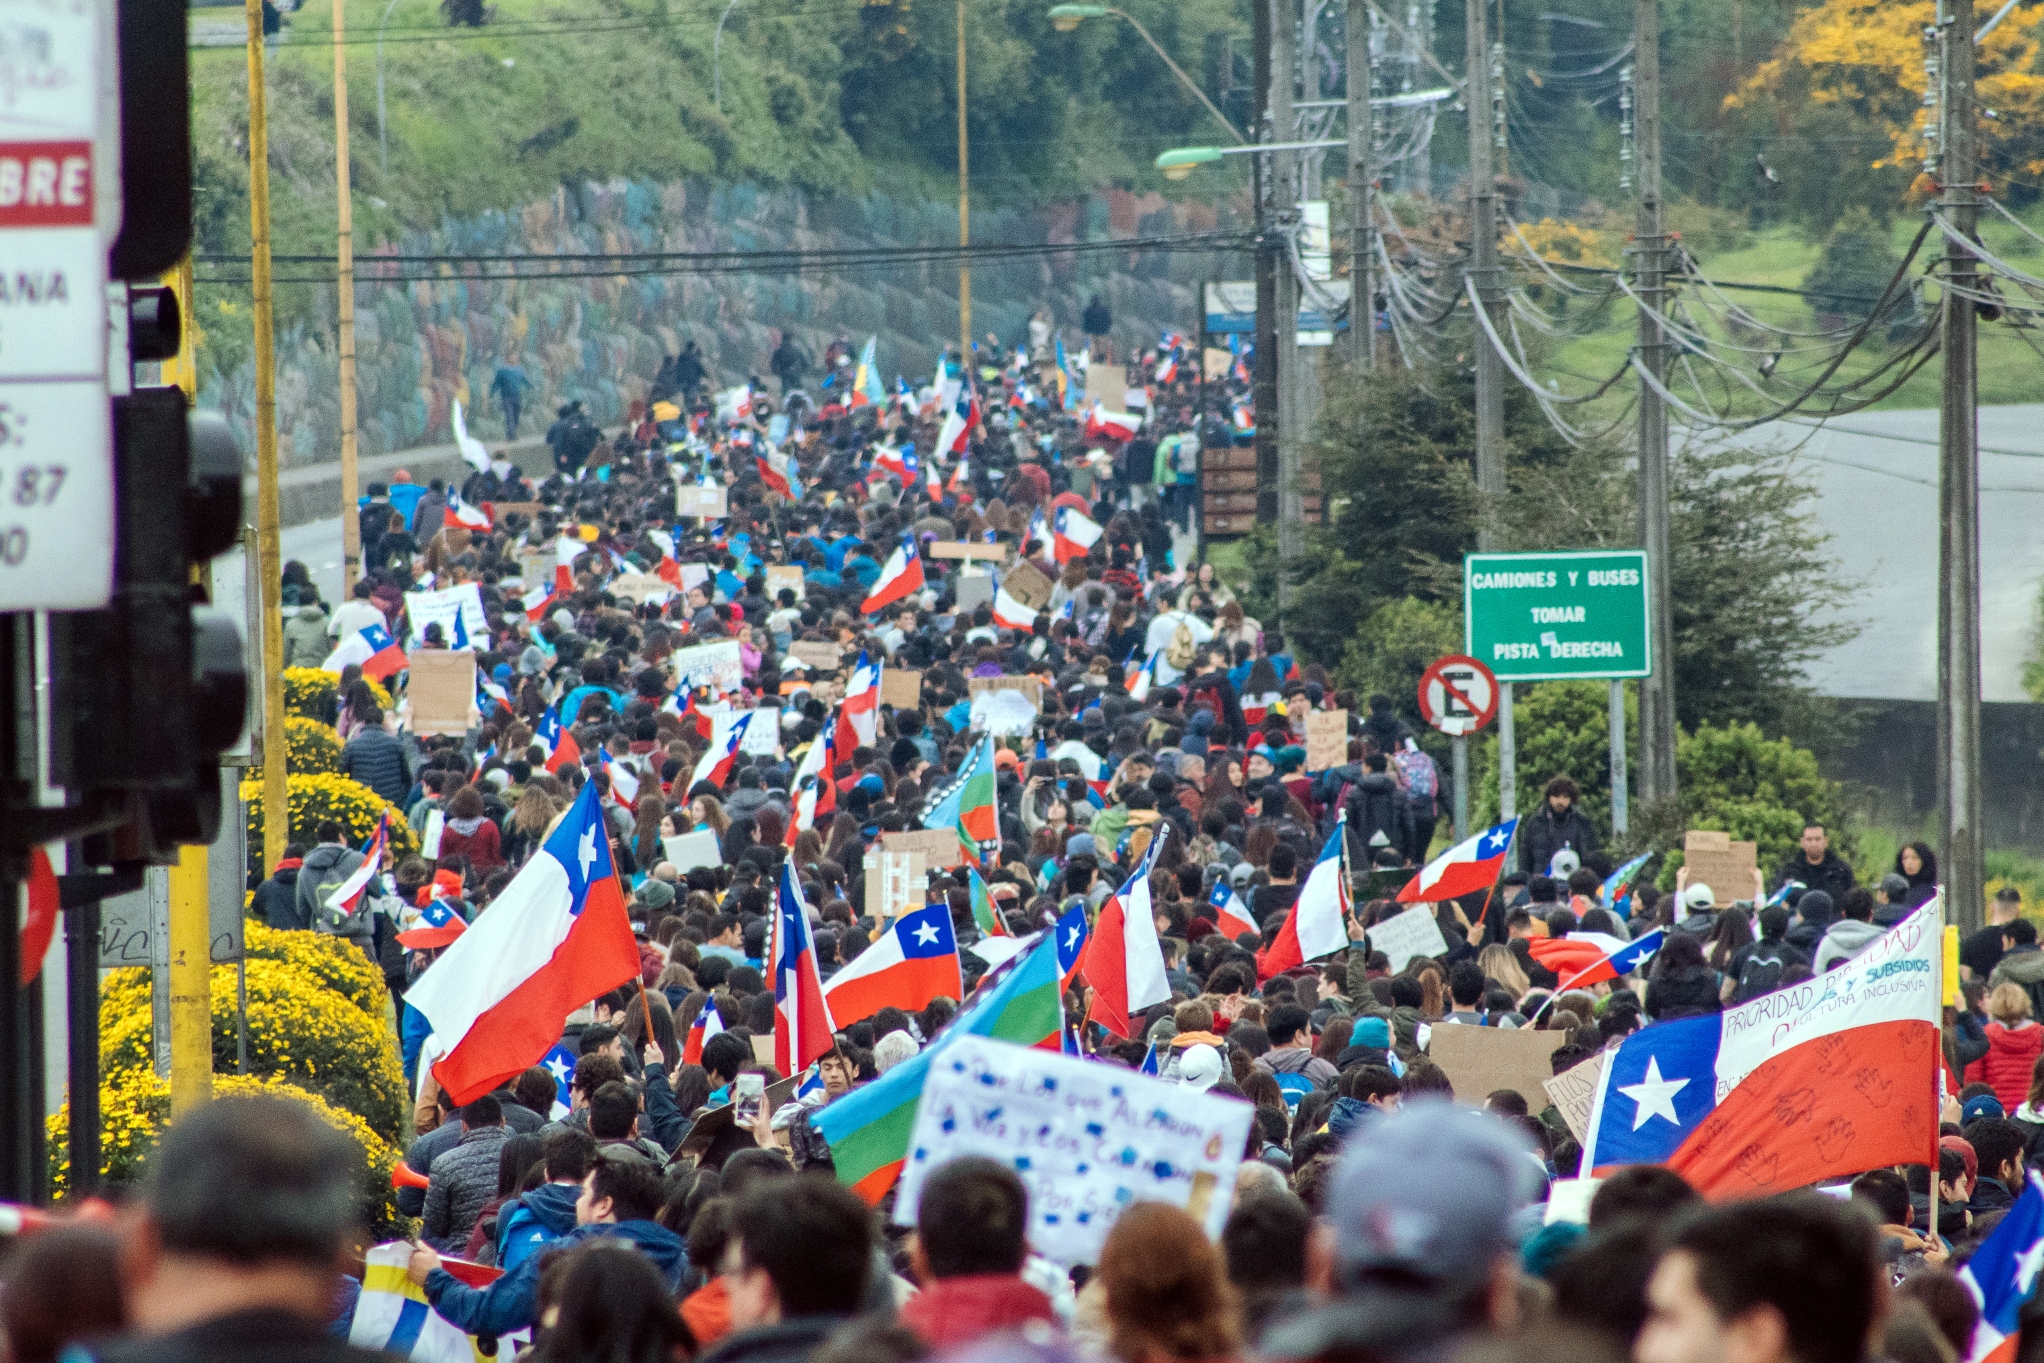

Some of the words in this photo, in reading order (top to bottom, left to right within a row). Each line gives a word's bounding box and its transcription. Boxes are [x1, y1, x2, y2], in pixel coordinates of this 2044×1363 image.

[1472, 571, 1557, 589] CAMIONES
[1568, 571, 1579, 587] Y
[1588, 569, 1640, 586] BUSES
[1530, 606, 1586, 623] TOMAR
[1493, 643, 1540, 660] PISTA
[1550, 641, 1623, 658] DERECHA
[1866, 959, 1931, 984] SUBSIDIOS
[1864, 979, 1928, 1002] INCLUSIVA
[1726, 986, 1814, 1038] PRIORIDAD
